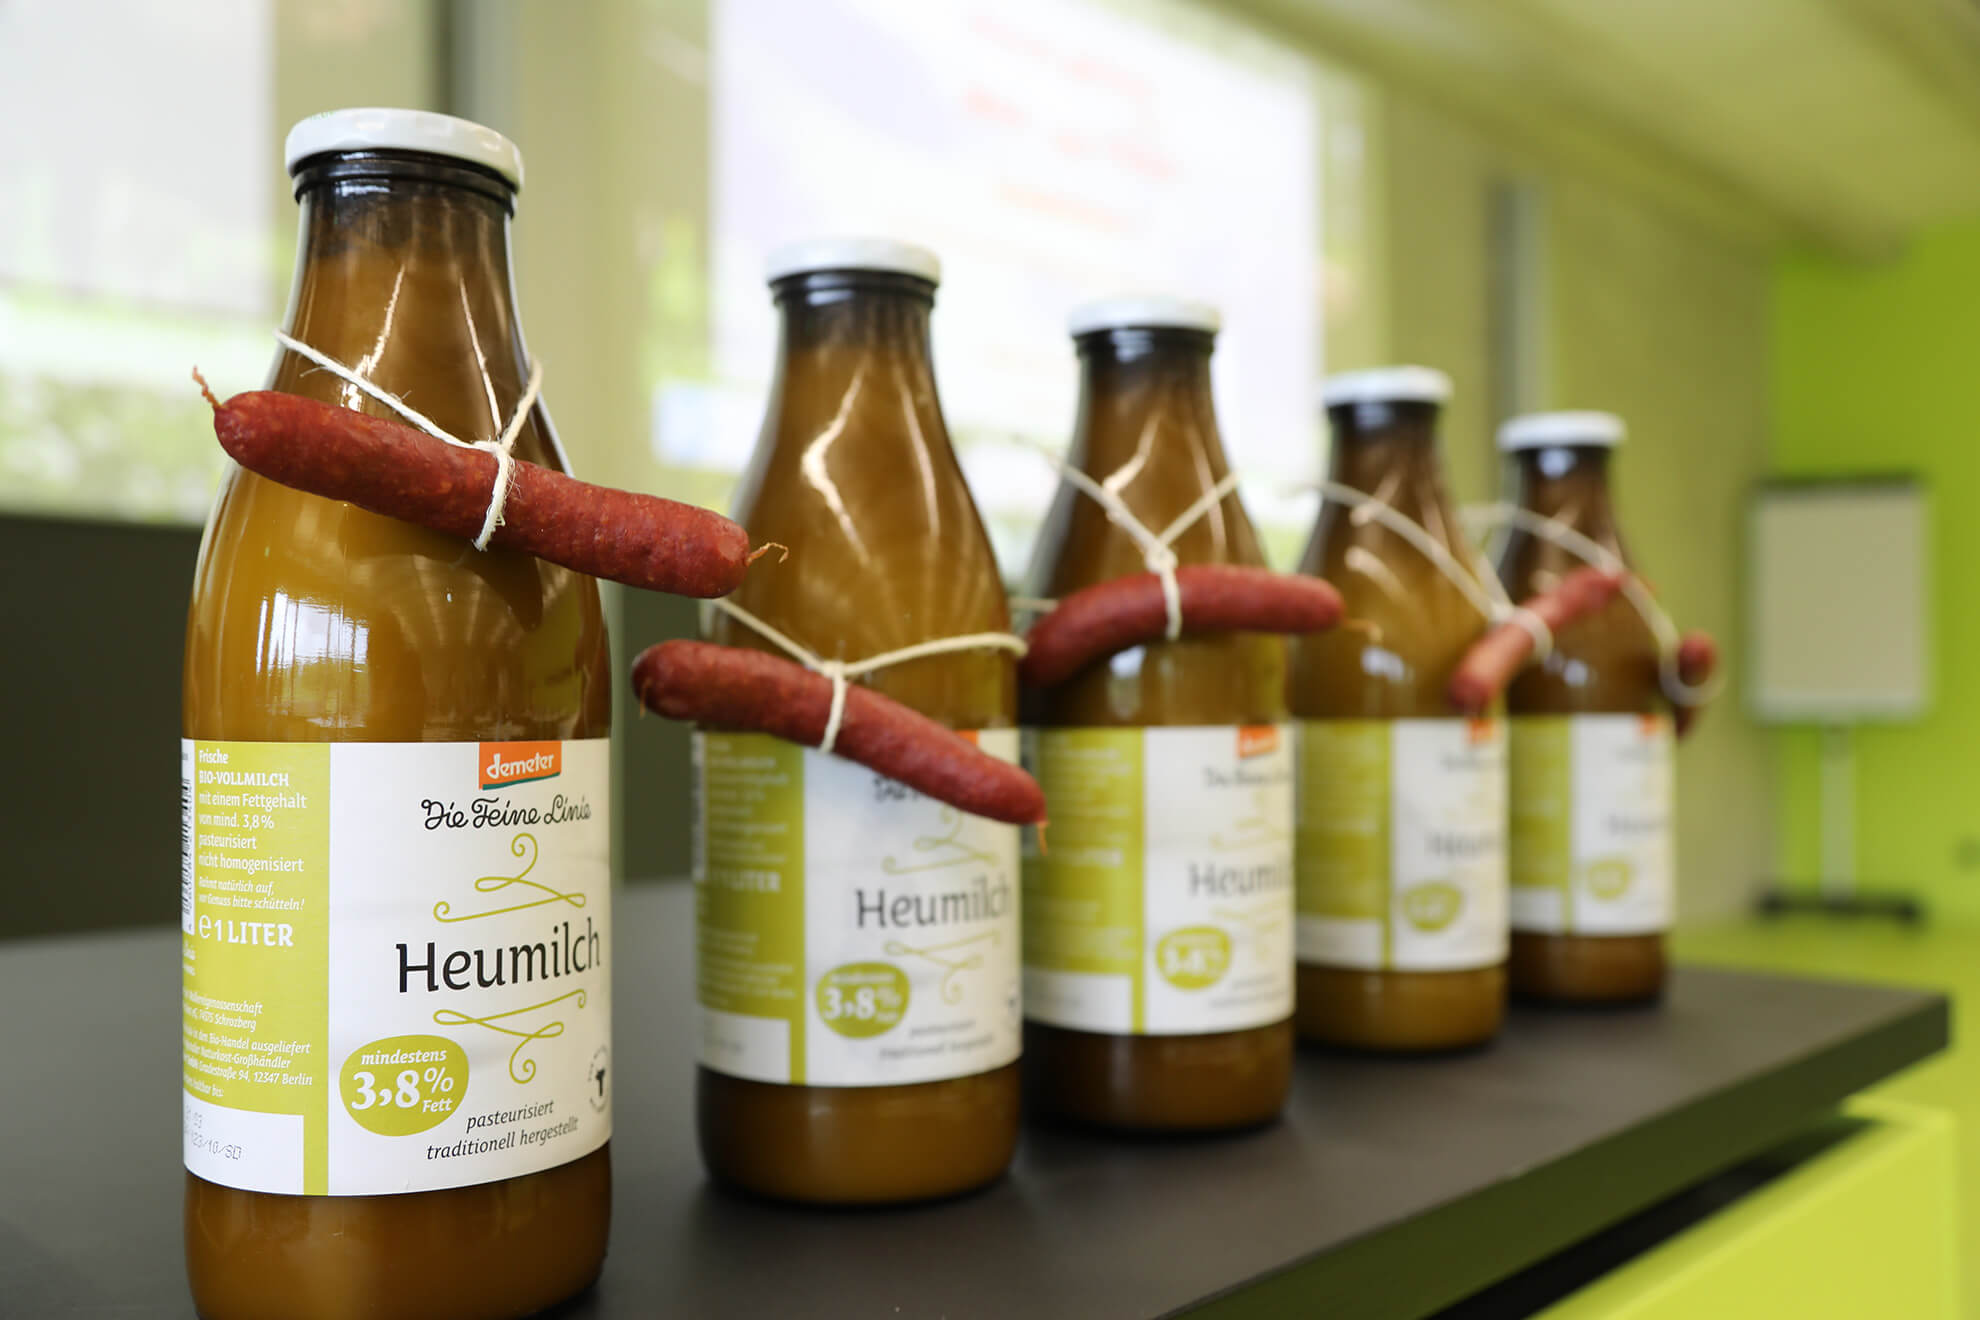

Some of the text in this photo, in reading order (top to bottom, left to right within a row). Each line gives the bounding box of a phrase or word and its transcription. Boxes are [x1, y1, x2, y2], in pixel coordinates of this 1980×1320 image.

[199, 748, 229, 764] Frische
[486, 752, 554, 779] demeter
[199, 770, 289, 787] BIO-VOLLMILCH
[212, 791, 240, 806] einem
[242, 791, 308, 812] Fettgehalt
[213, 812, 240, 828] mind.
[421, 794, 592, 830] Die Feine Linie
[199, 833, 256, 850] pasteurisiert
[220, 853, 304, 876] homogenisiert
[253, 898, 305, 912] schütteln!
[227, 920, 294, 947] LITER
[395, 916, 601, 993] Heumilch
[251, 1040, 311, 1056] ausgeliefert
[361, 1048, 447, 1065] mindestens
[253, 1071, 280, 1084] 12347
[281, 1073, 313, 1086] Berlin
[422, 1098, 453, 1113] Fett
[466, 1100, 554, 1133] pasteurisiert
[426, 1116, 579, 1160] traditionell hergestellt
